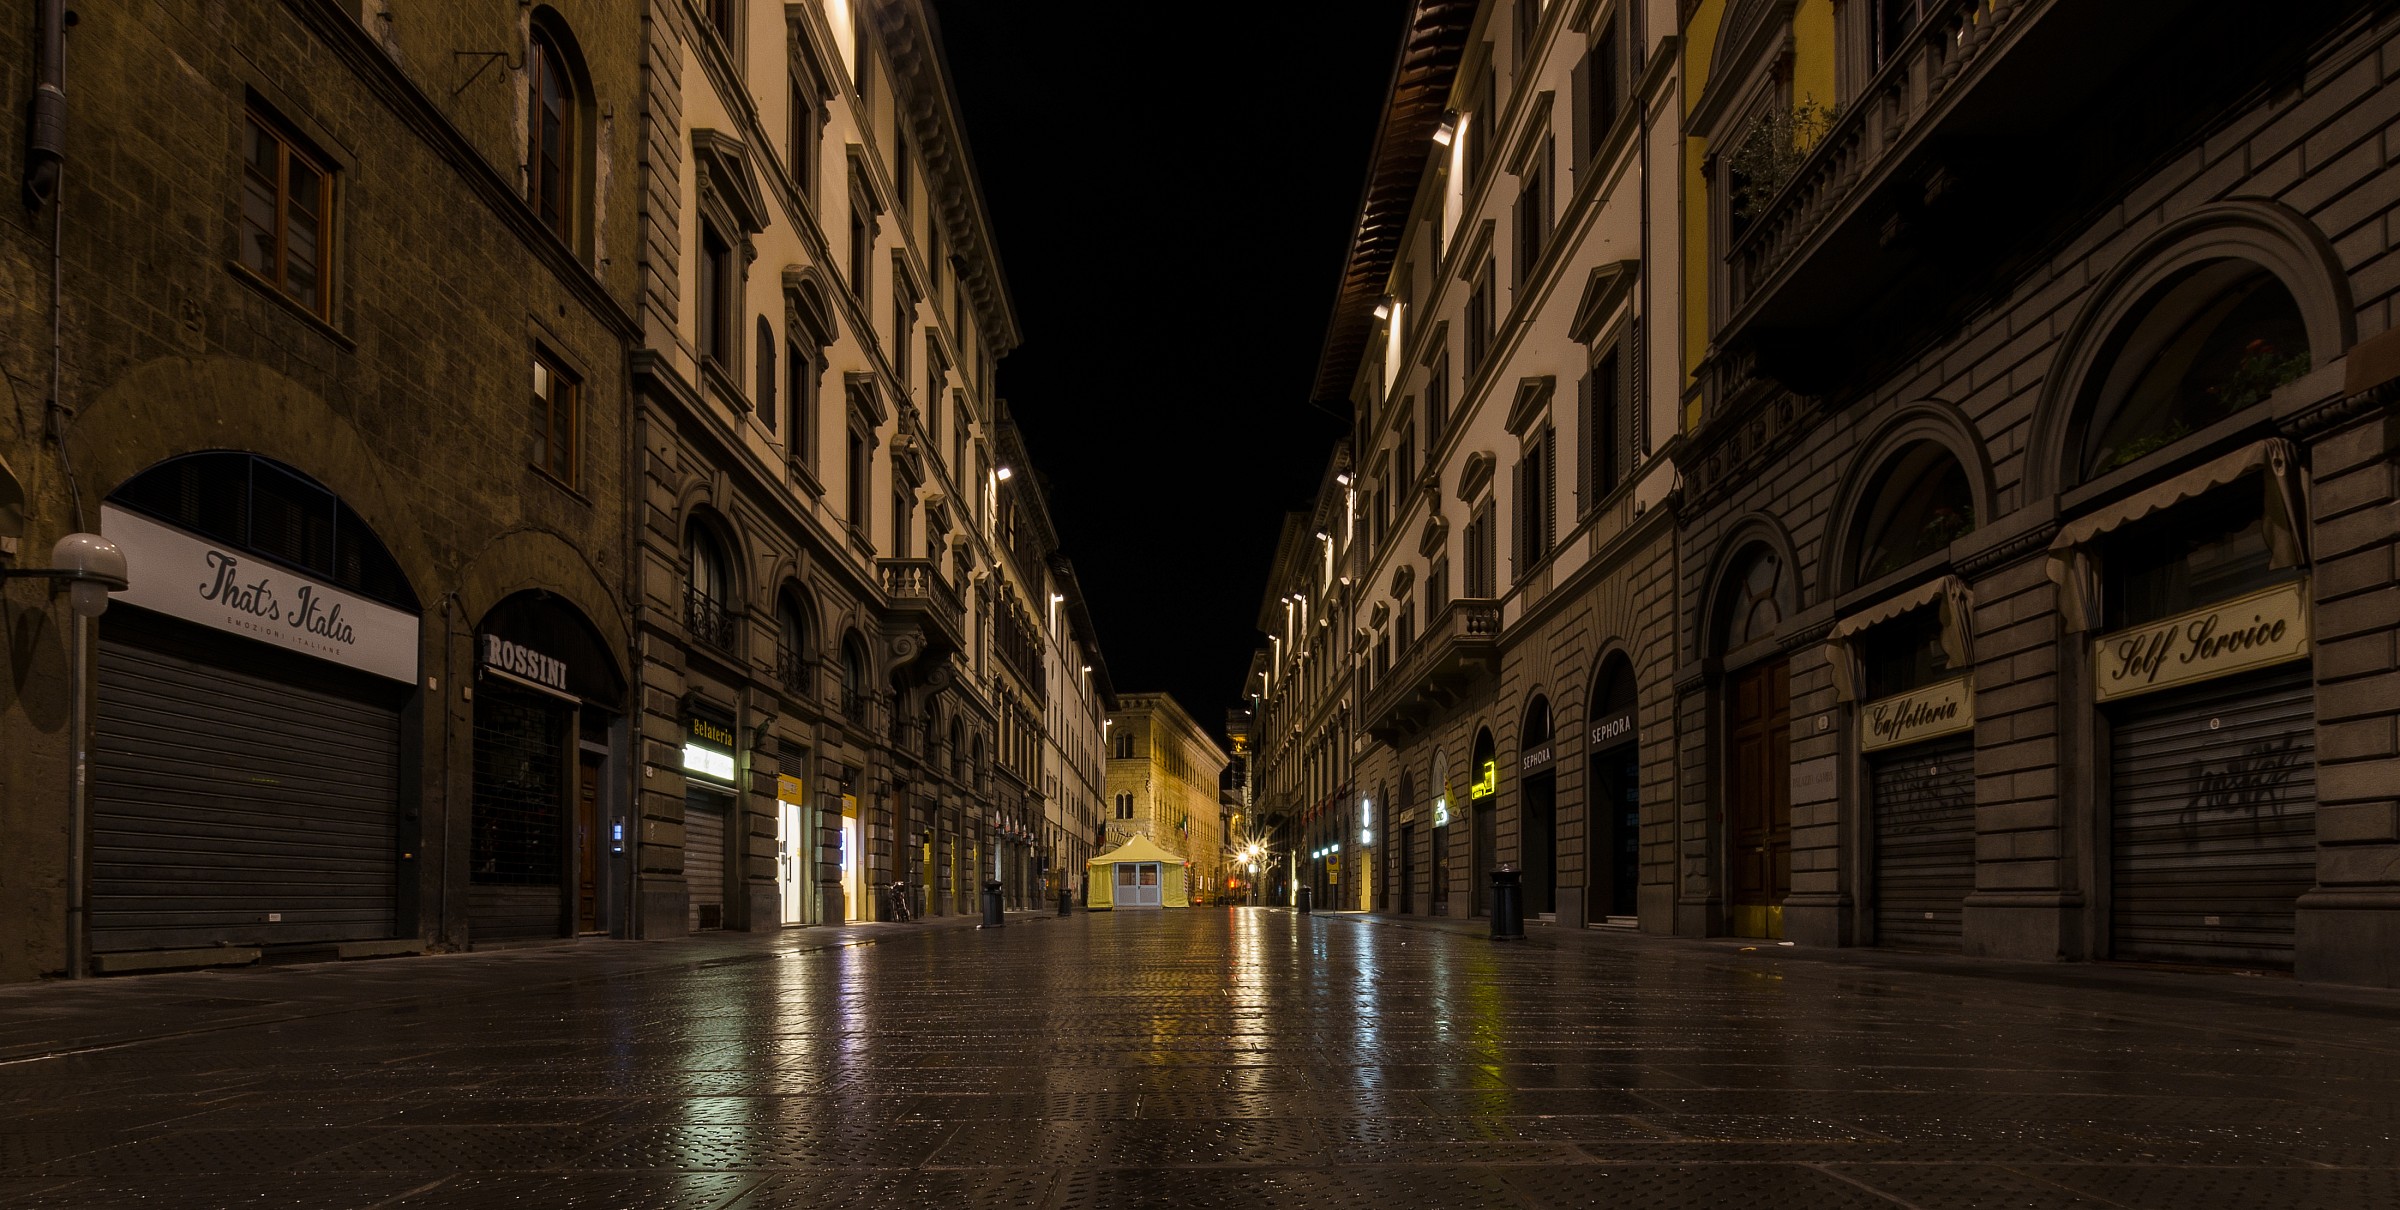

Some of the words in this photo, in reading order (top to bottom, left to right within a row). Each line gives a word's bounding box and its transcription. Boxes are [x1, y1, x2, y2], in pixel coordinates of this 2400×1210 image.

[199, 550, 280, 620] That's
[288, 585, 356, 645] Italia
[228, 616, 285, 639] EMOZIONI
[293, 636, 340, 656] ITALIANE
[2112, 625, 2179, 682] Self
[2180, 614, 2286, 664] Service
[485, 634, 567, 690] ROSSINI
[694, 718, 733, 747] gelateria
[1591, 715, 1631, 744] SEPHORA
[1873, 697, 1957, 741] Caffetteria
[1523, 747, 1551, 770] SEPHORA
